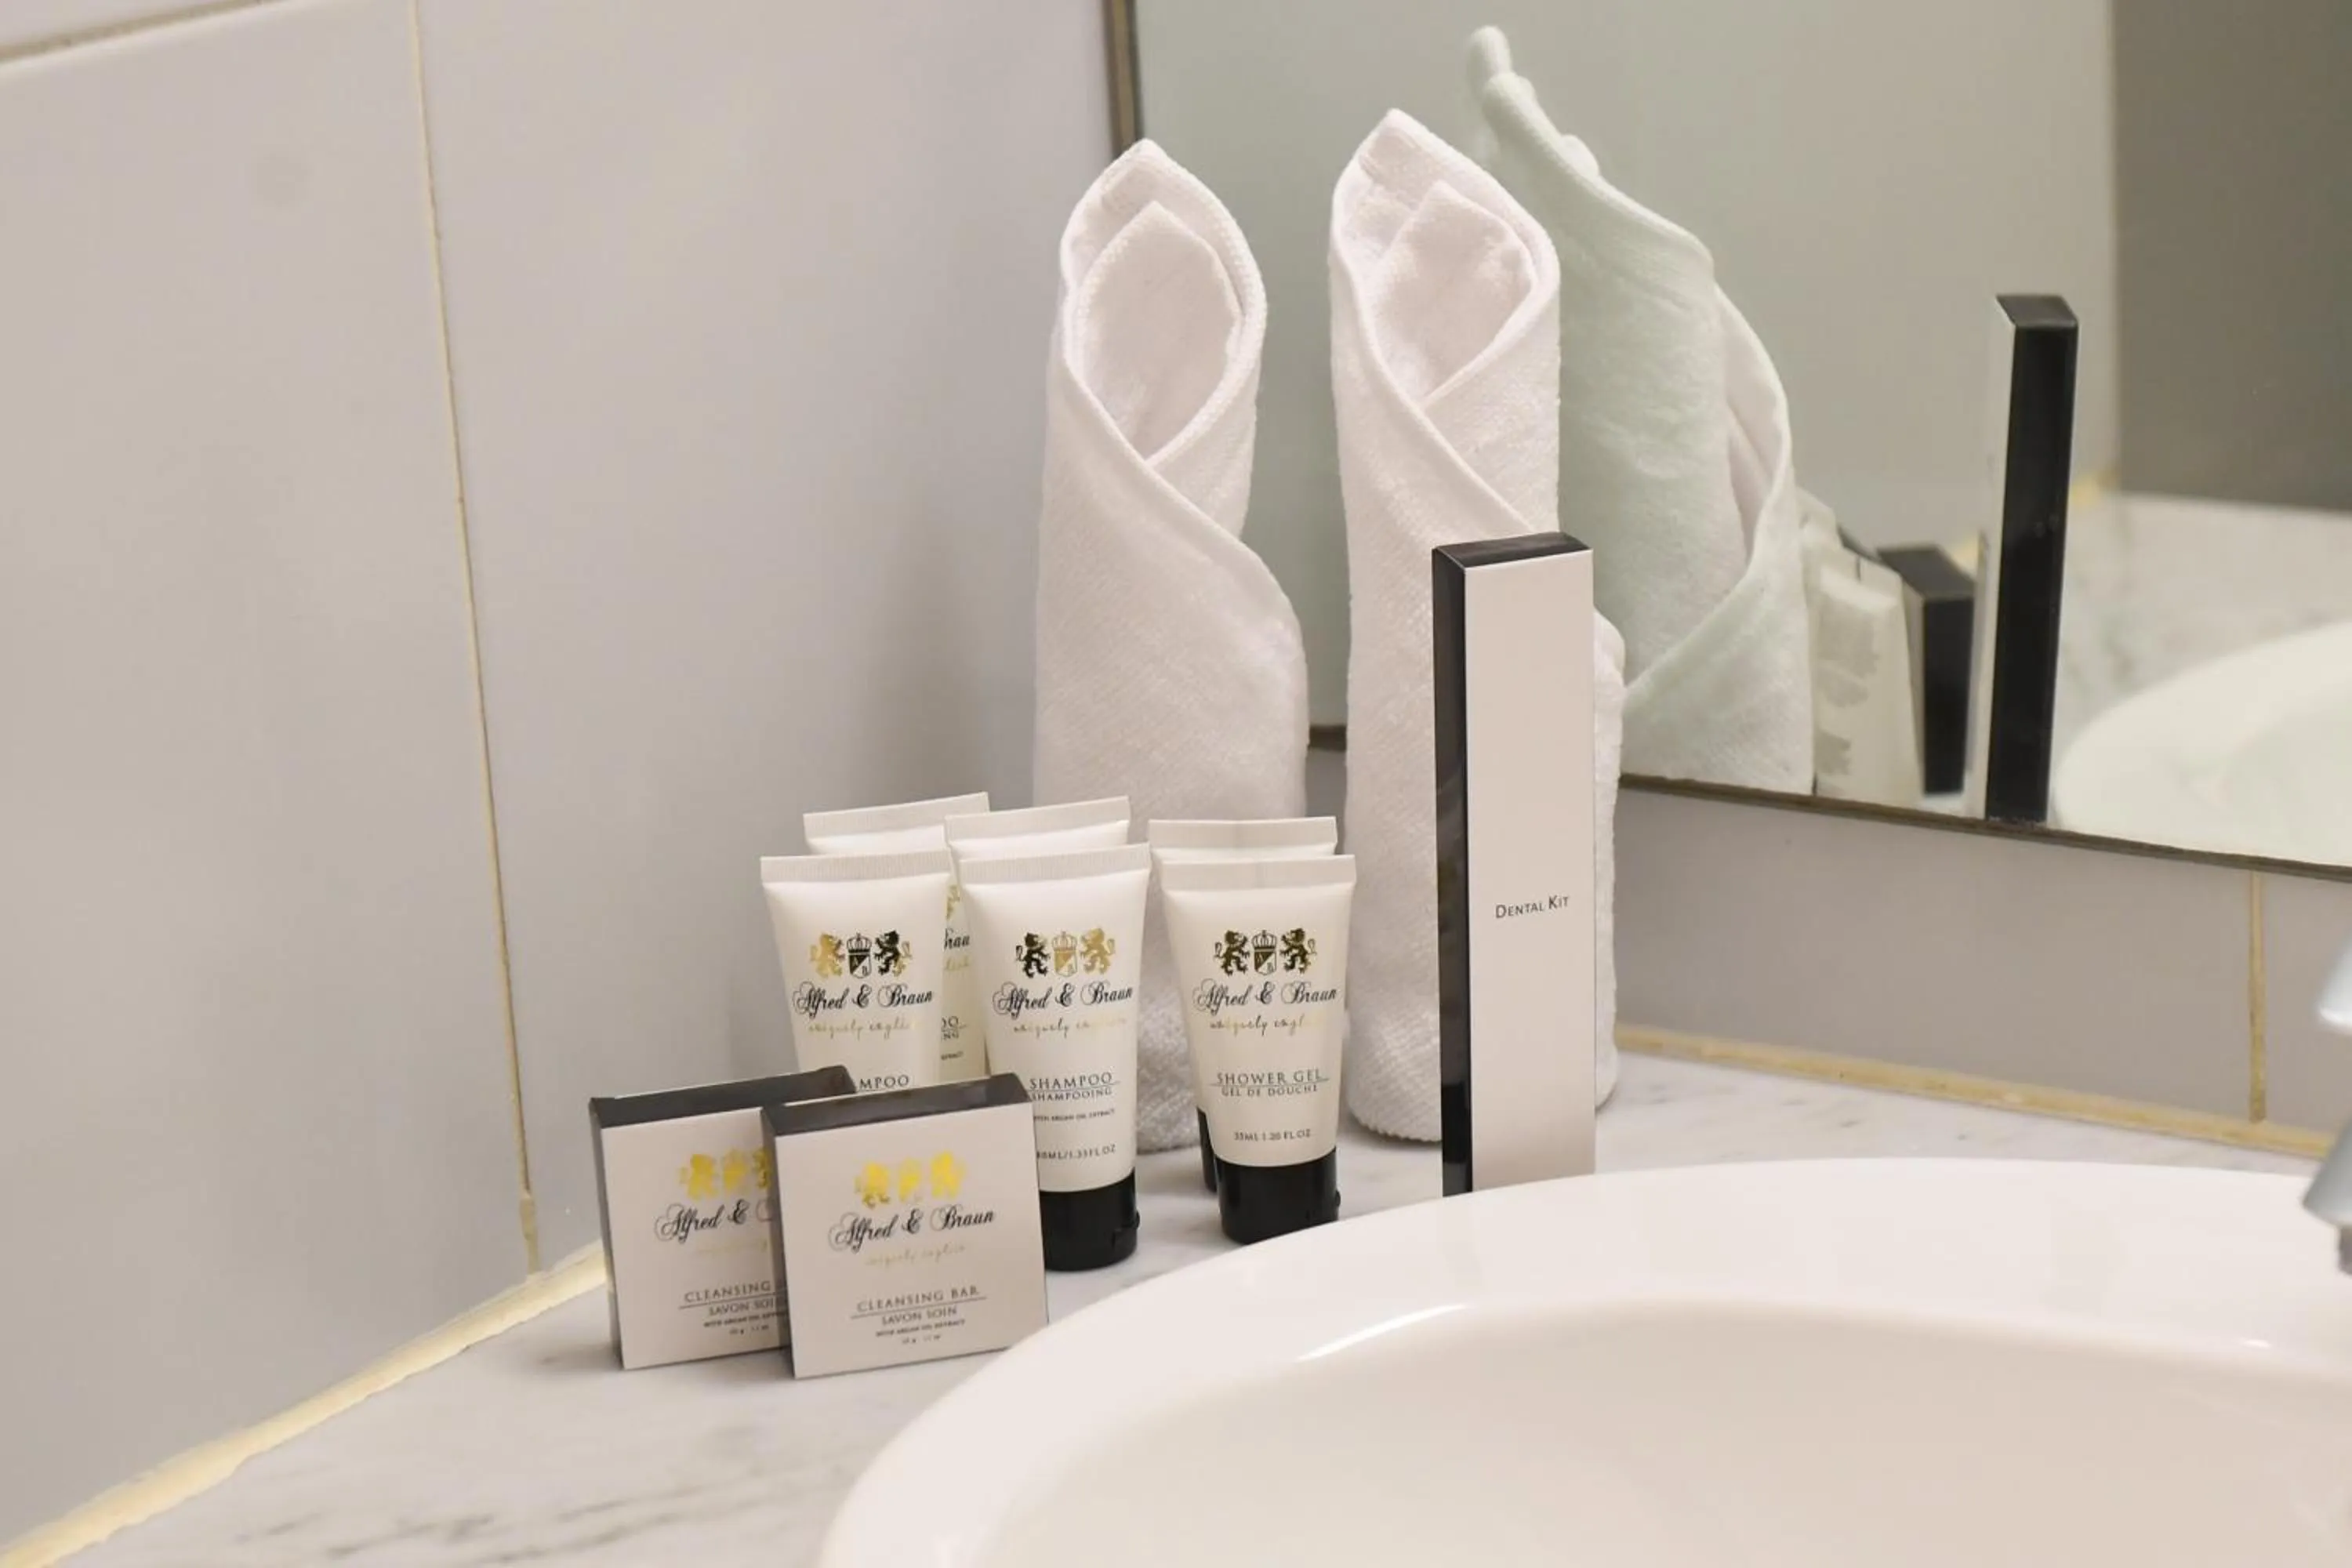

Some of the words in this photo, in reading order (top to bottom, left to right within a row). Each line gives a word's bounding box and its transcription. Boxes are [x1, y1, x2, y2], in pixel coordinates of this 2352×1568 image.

[792, 981, 849, 1019] Alfred
[852, 983, 872, 1009] &
[877, 982, 934, 1008] Braun
[993, 982, 1053, 1020] Alfred
[1055, 982, 1075, 1007] &
[1080, 980, 1133, 1006] Braun
[1191, 978, 1253, 1016] Alfred
[1254, 981, 1276, 1005] &
[1280, 980, 1337, 1005] Braun
[858, 1074, 909, 1090] MPOO
[1029, 1072, 1112, 1090] SHAMPOO
[1217, 1071, 1287, 1086] SHOWER
[1293, 1069, 1321, 1083] GEL
[1267, 1083, 1317, 1097] DOUCHE
[655, 1203, 725, 1244] Alfred
[828, 1212, 898, 1254] Alfred
[901, 1209, 924, 1235] &
[930, 1204, 995, 1232] Braun
[684, 1279, 771, 1303] CLEANSING
[856, 1290, 945, 1313] CLEANSING
[950, 1285, 980, 1300] BAR
[881, 1312, 922, 1327] SAVON
[927, 1305, 957, 1319] SOIN
